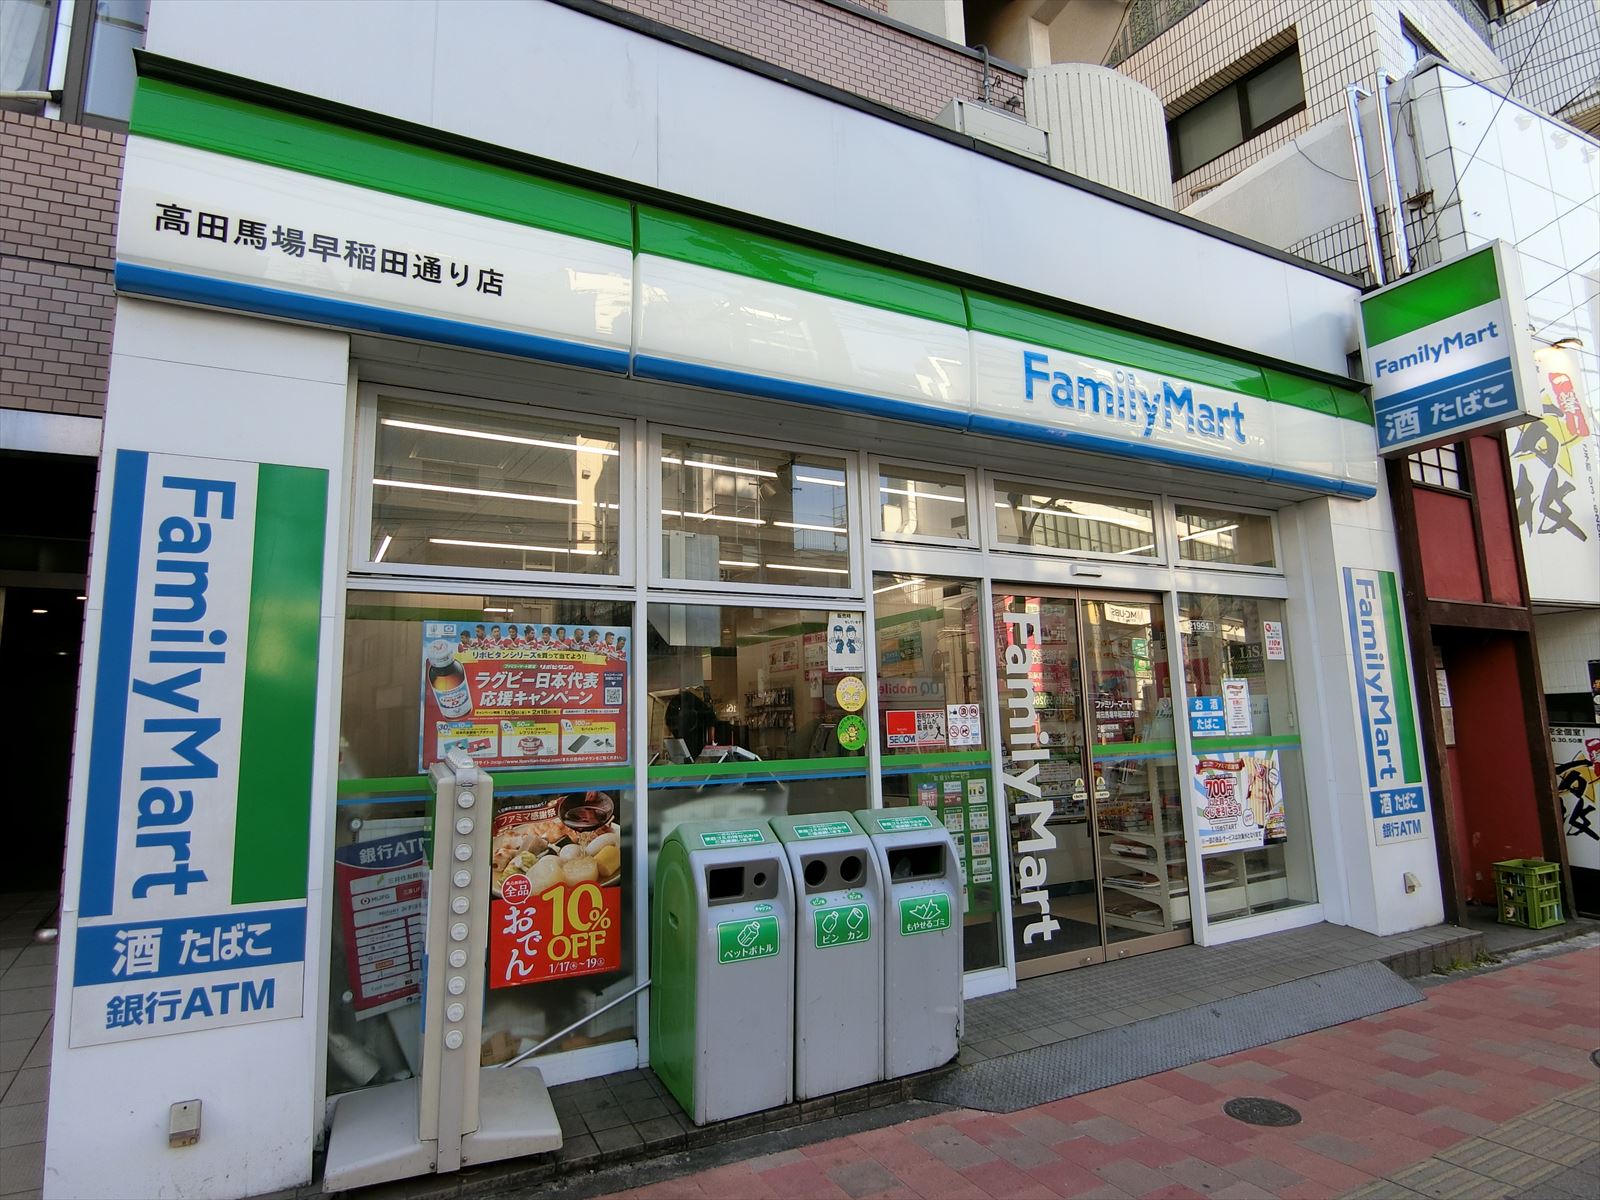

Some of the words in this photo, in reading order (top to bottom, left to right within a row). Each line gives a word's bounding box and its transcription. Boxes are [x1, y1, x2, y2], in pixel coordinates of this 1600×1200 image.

[155, 202, 504, 297] 高田馬場早稲田通り店
[1375, 321, 1499, 378] FamilyMart
[1023, 350, 1247, 444] FamilyMart
[1384, 406, 1420, 441] 酒
[1430, 384, 1508, 425] たばこ
[132, 475, 237, 900] FamilyMart
[475, 671, 599, 690] ラグビー日本代表
[1355, 578, 1397, 781] FamilyMart
[479, 690, 594, 707] 応援キャンペーン
[1095, 700, 1132, 710] ファミリーマート
[1197, 718, 1220, 730] たばこ
[889, 734, 916, 744] SECOM
[1002, 612, 1061, 944] FamilyMart
[1380, 793, 1393, 815] 酒
[1394, 792, 1418, 811] たばこ
[500, 810, 557, 826] ファミマ感謝祭
[1382, 819, 1422, 838] 銀行ATM
[505, 885, 529, 897] 全品
[542, 883, 611, 936] 10%
[822, 934, 840, 944] ビン
[848, 930, 865, 941] カン
[907, 918, 946, 932] もやせるゴミ
[111, 928, 163, 976] 酒
[179, 922, 272, 965] たばこ
[502, 906, 542, 980] おでん
[547, 930, 606, 961] OFF
[724, 944, 775, 959] ペットボトル
[105, 978, 275, 1029] 銀行ATM
